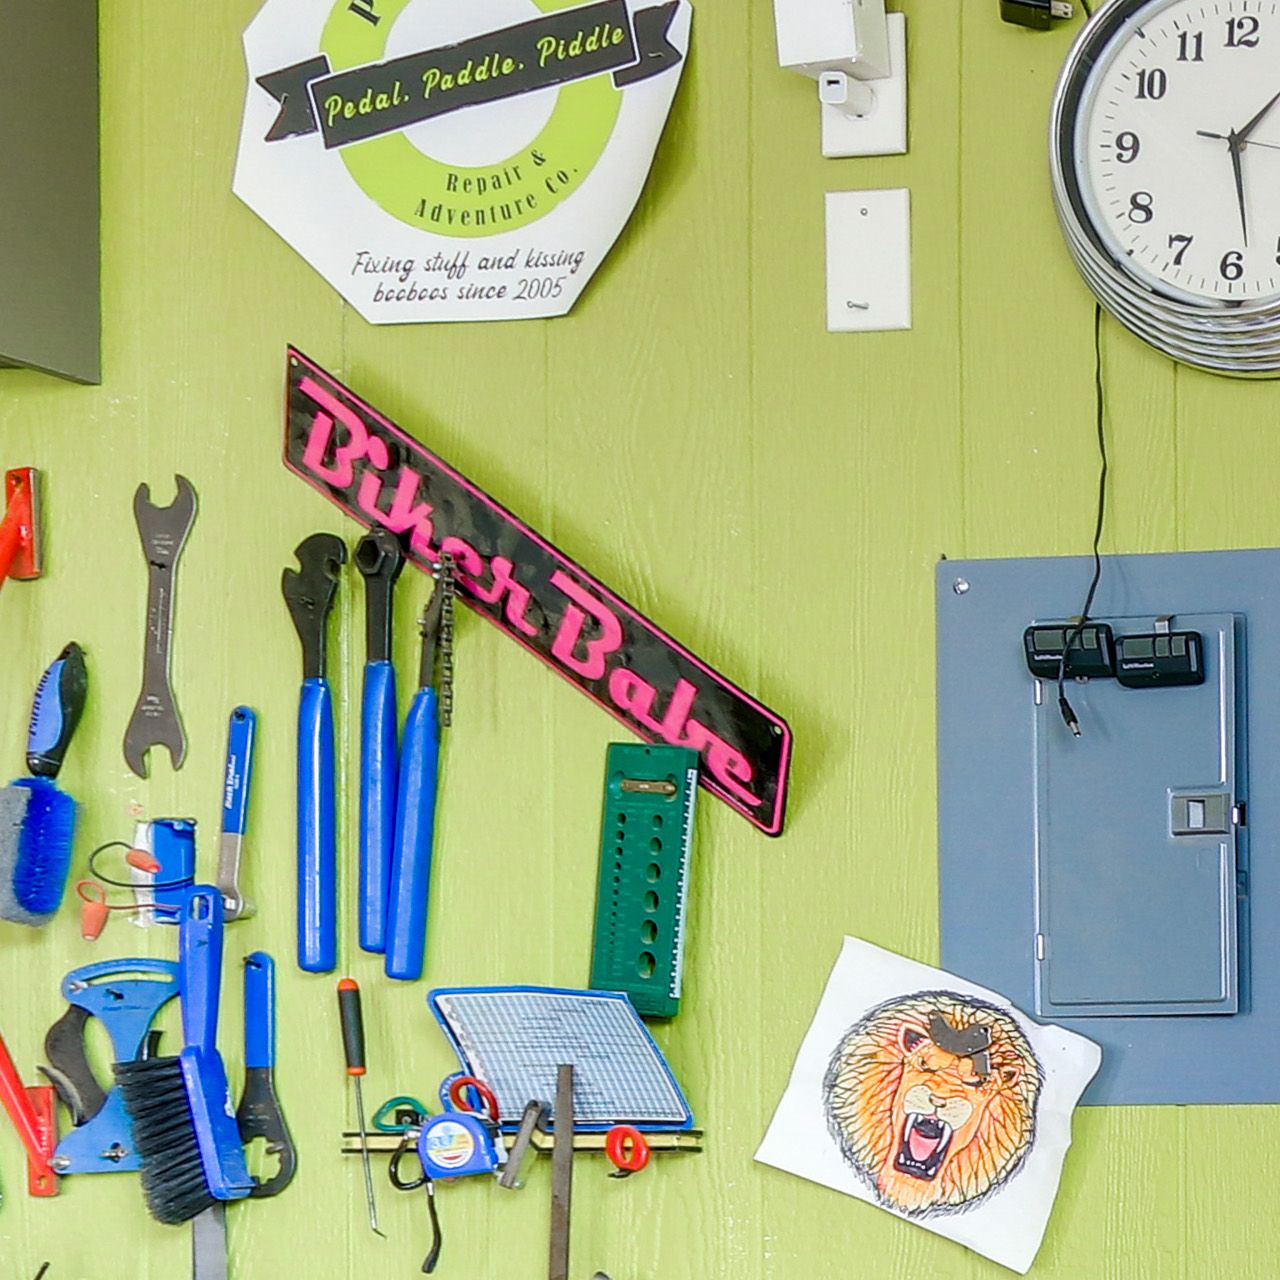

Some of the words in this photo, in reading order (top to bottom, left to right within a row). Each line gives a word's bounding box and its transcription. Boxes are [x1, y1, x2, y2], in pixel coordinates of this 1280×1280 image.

[1175, 30, 1205, 62] 11
[1224, 16, 1260, 47] 12
[324, 89, 409, 127] Pedal.
[421, 55, 525, 95] Paddle.
[536, 23, 625, 68] Piddle
[1135, 68, 1167, 99] 10
[1114, 131, 1141, 163] 9
[447, 164, 522, 193] Repair
[531, 148, 547, 166] &
[414, 189, 538, 227] Adventure
[546, 167, 579, 194] Co.
[1127, 191, 1154, 224] 8
[351, 250, 415, 281] Fixing
[423, 250, 470, 280] stuff
[477, 248, 517, 272] and
[524, 248, 586, 274] kissing
[1168, 234, 1194, 266] 7
[1219, 250, 1244, 281] 6
[373, 281, 448, 303] booboos
[457, 282, 507, 300] since
[513, 278, 566, 301] 2005
[298, 375, 539, 637] Biker
[550, 569, 763, 807] Babe
